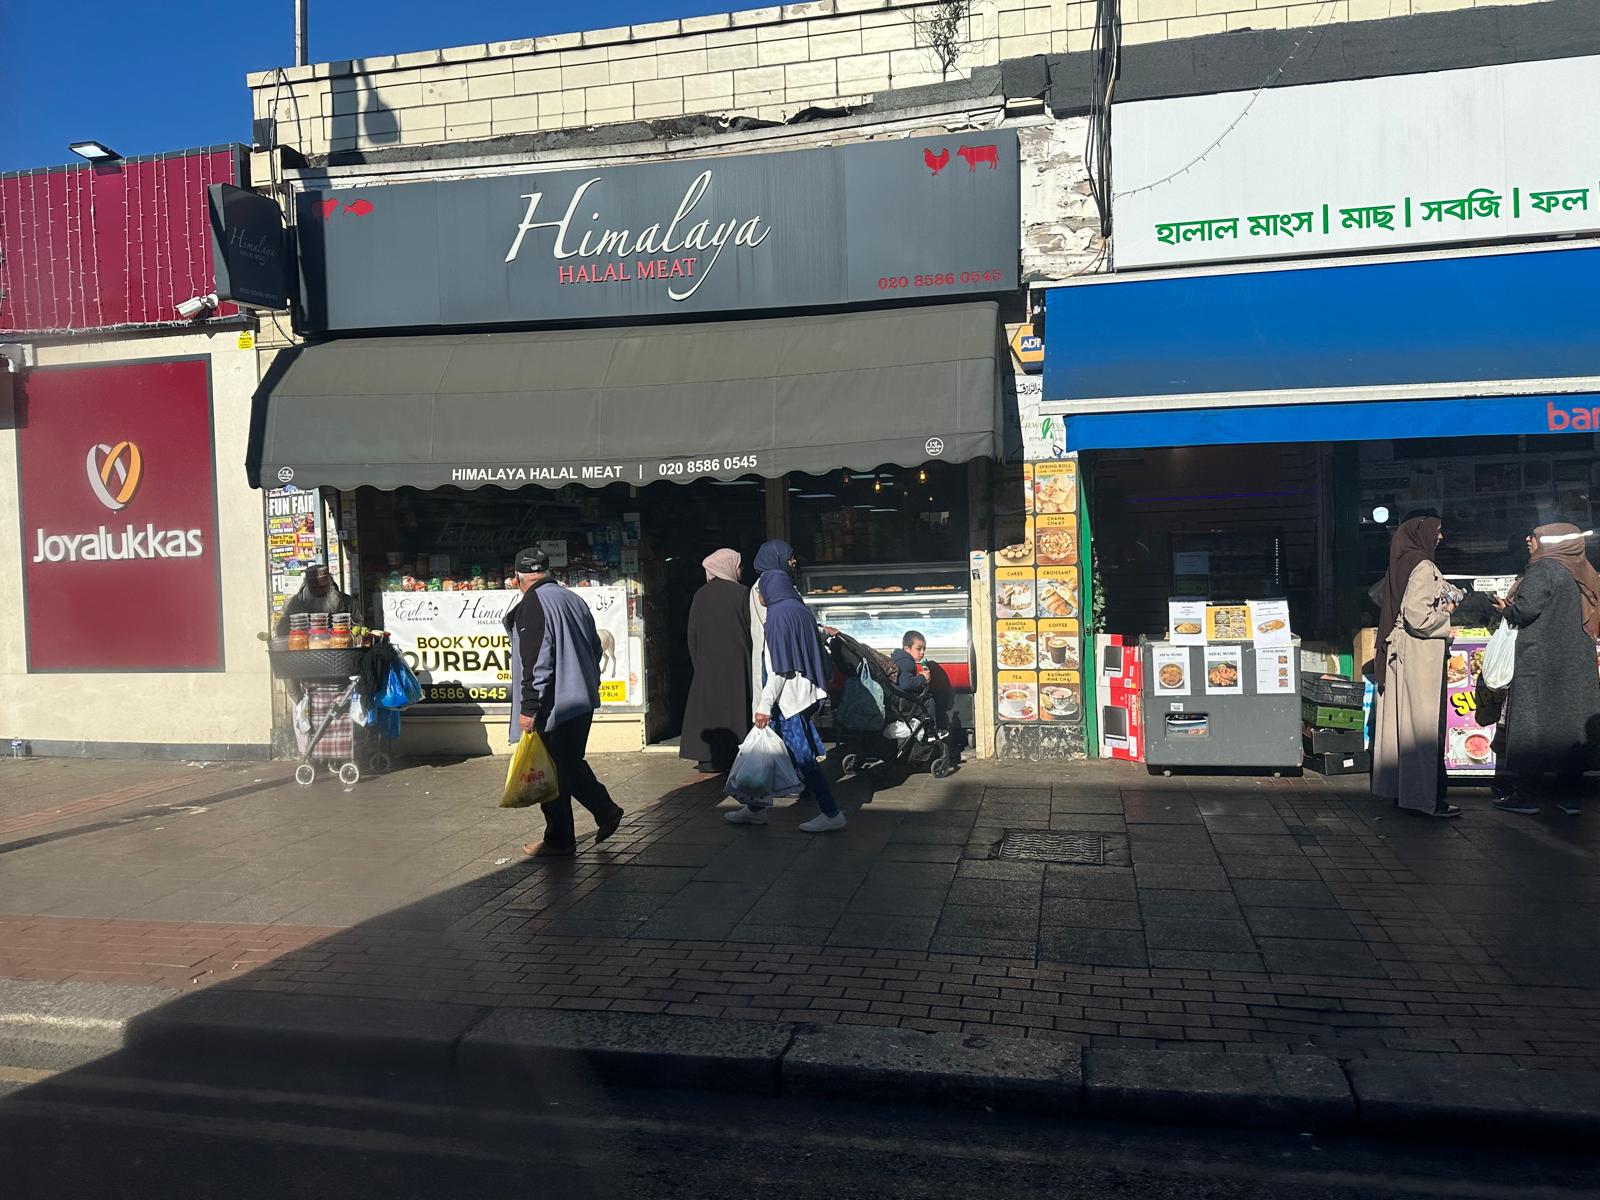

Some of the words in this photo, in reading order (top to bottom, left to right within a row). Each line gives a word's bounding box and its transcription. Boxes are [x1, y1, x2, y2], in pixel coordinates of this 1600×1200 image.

[1155, 217, 1239, 246] হালাল
[1247, 211, 1314, 239] মাংস
[1339, 204, 1396, 232] মাছ
[1420, 188, 1503, 223] সবজি
[1530, 188, 1590, 214] ফল
[505, 169, 771, 301] Himalaya
[558, 262, 631, 285] HALAL
[636, 257, 698, 281] MEAT
[878, 276, 909, 290] 020
[913, 272, 955, 287] 8586
[1021, 338, 1042, 350] ADT
[452, 467, 525, 481] HIMALAYA
[529, 467, 578, 480] HALAL
[581, 465, 623, 479] MEAT
[658, 462, 683, 476] 020
[686, 458, 720, 474] 8586
[723, 455, 758, 470] 0545
[269, 497, 290, 516] FUN
[292, 495, 314, 514] FAIR
[33, 523, 203, 563] Joyalukkas
[395, 598, 426, 621] Eid
[458, 593, 520, 619] Himal
[417, 637, 464, 649] BOOK
[468, 636, 512, 648] YOUR
[402, 650, 513, 672] QURBA
[430, 687, 465, 699] 8586
[469, 687, 507, 699] 0545
[1450, 691, 1477, 716] SU
